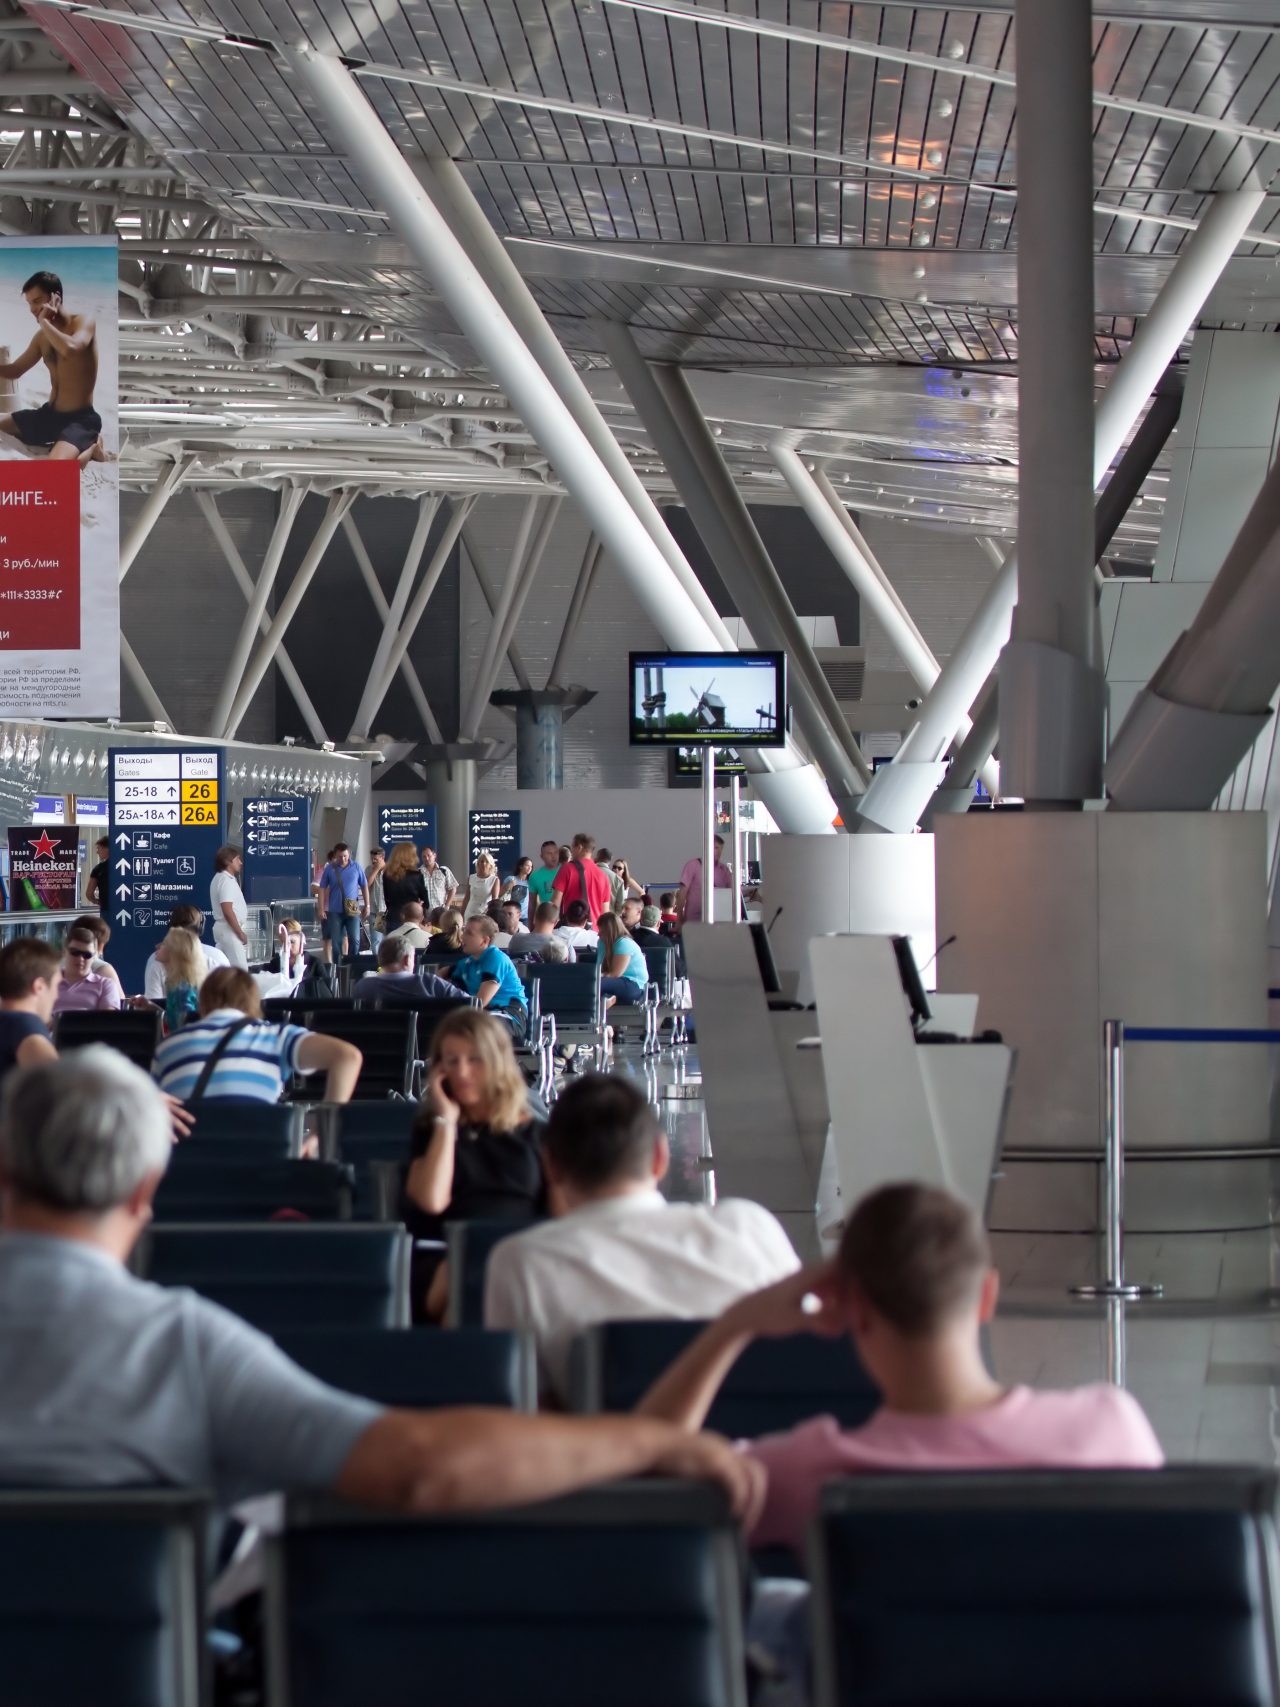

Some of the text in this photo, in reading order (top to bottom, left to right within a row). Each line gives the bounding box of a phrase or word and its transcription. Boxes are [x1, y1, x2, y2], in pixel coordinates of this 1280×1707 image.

[3, 558, 10, 568] 3
[12, 558, 59, 570] руб./мин
[118, 757, 153, 765] Выходы
[185, 756, 213, 764] Выход
[118, 769, 140, 777] Gates
[190, 768, 209, 776] Gate
[125, 786, 158, 797] 25-18
[189, 783, 210, 799] 26
[153, 832, 170, 840] Кафе
[13, 860, 75, 871] Heineken
[153, 883, 193, 891] Магазины
[153, 893, 178, 901] Shops
